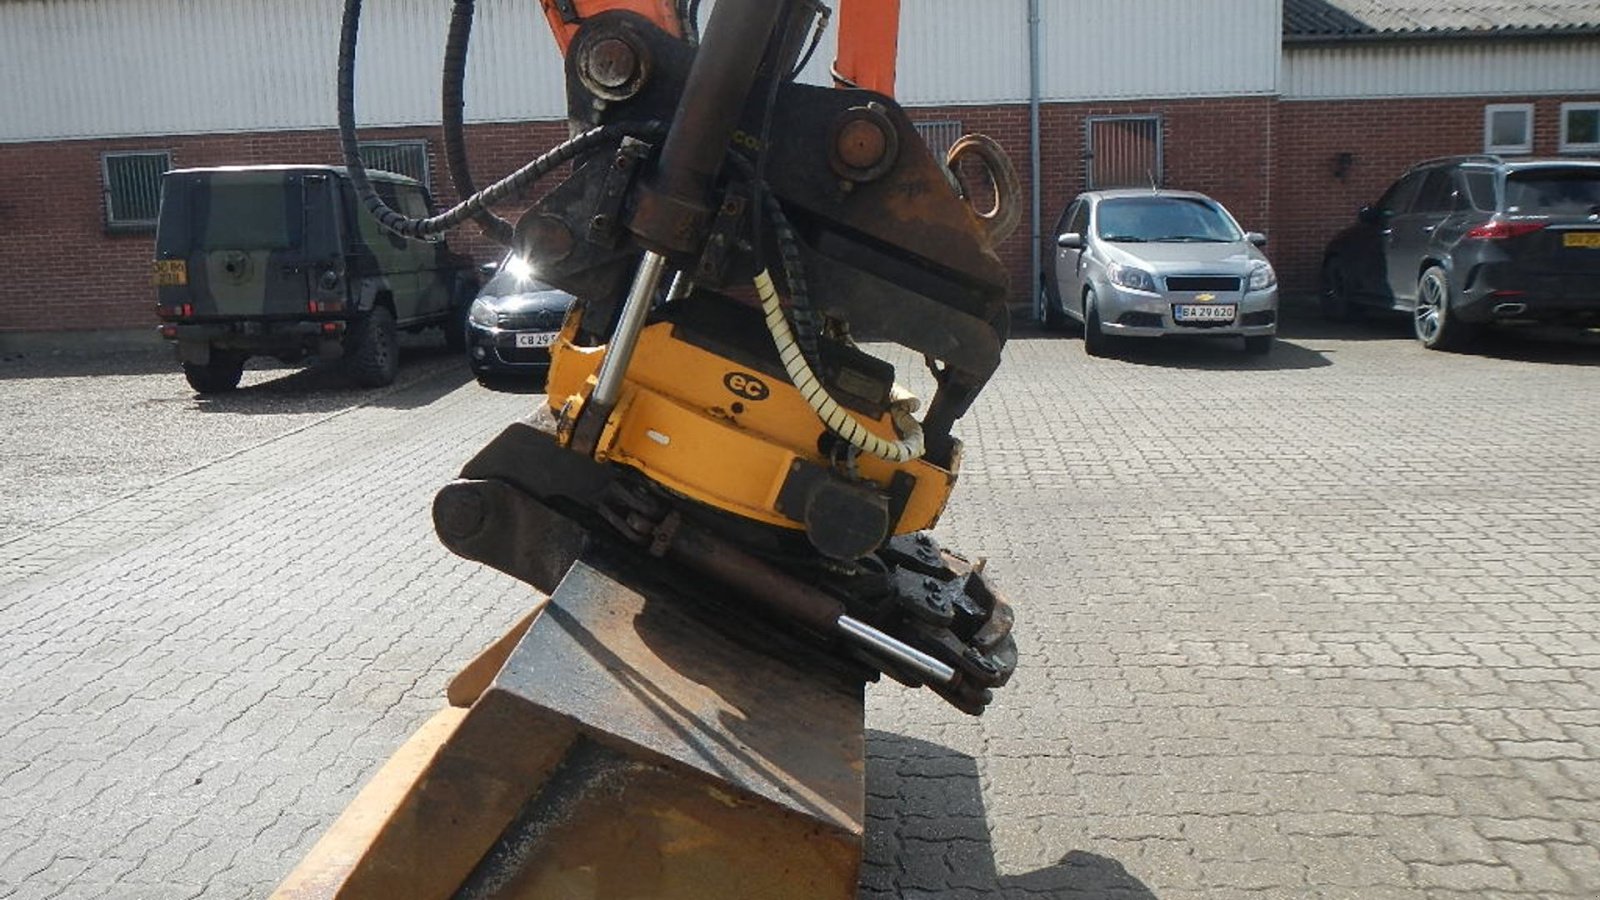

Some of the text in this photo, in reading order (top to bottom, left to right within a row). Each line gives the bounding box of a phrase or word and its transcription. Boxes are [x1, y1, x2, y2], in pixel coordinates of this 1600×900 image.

[1182, 307, 1233, 317] BA 29 620
[520, 335, 534, 345] CB
[729, 374, 763, 397] ec
